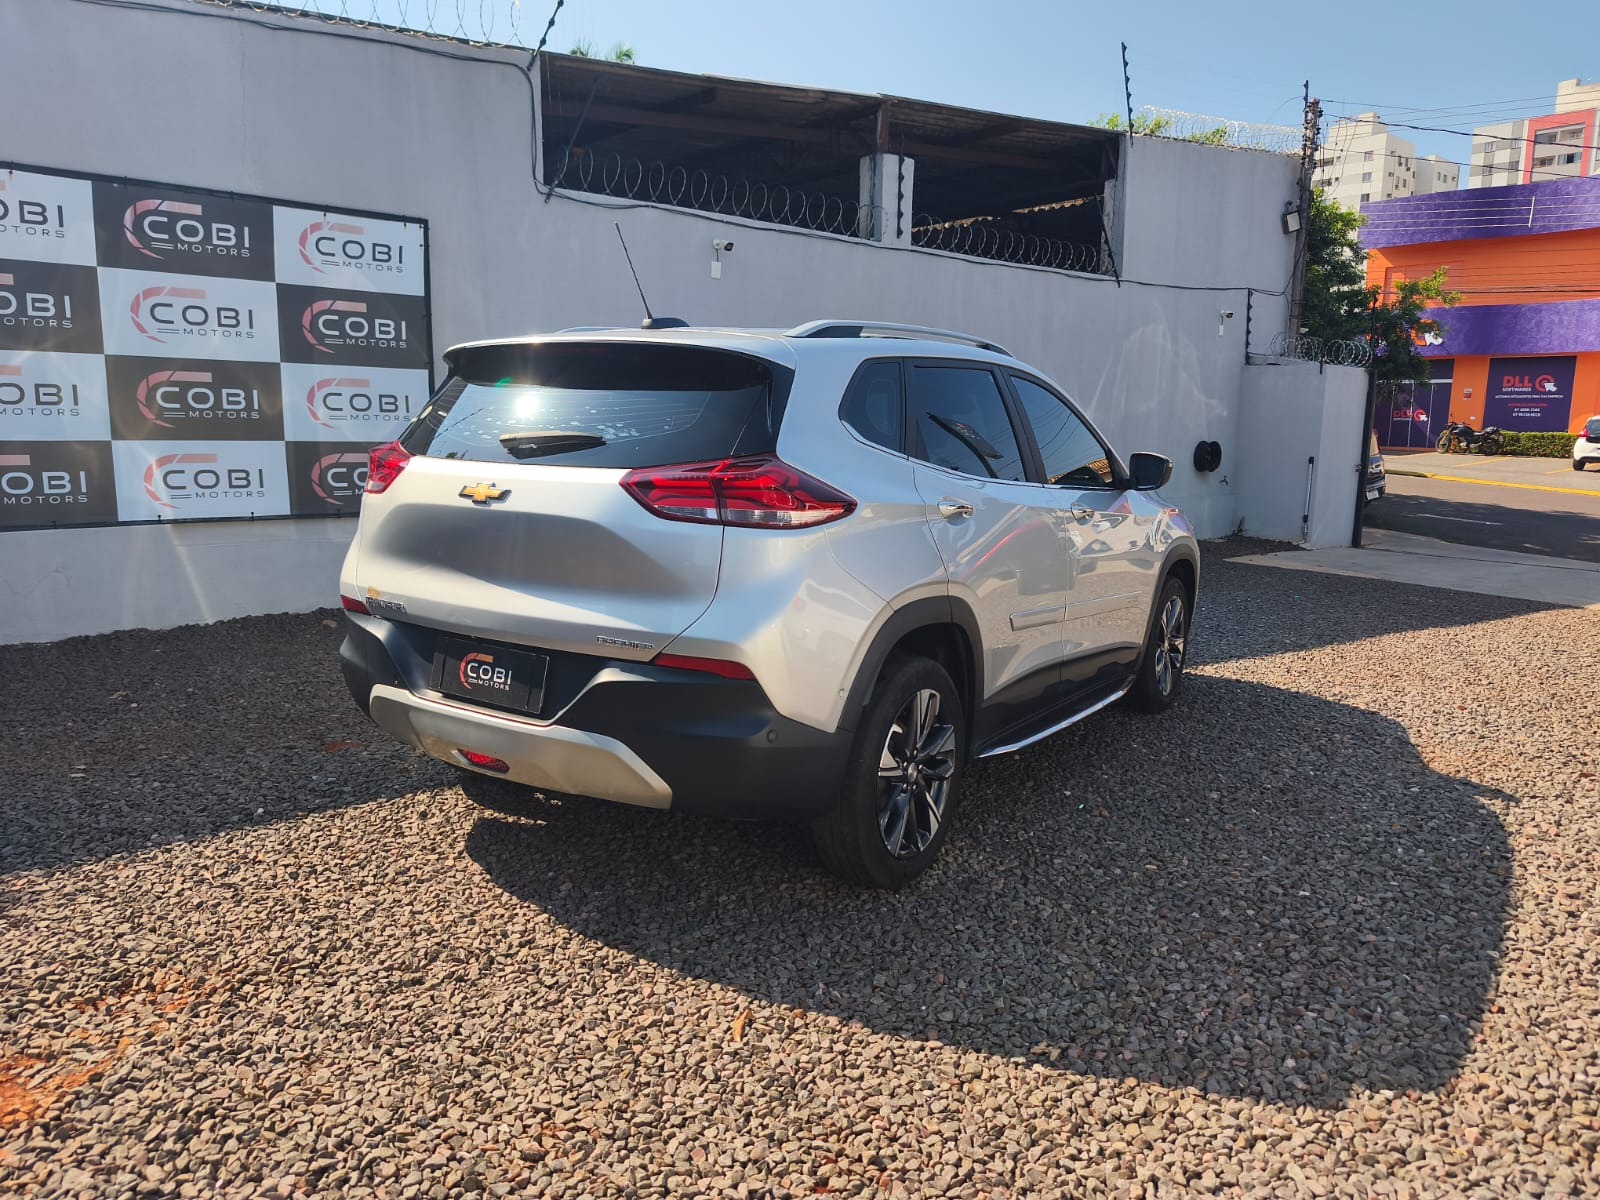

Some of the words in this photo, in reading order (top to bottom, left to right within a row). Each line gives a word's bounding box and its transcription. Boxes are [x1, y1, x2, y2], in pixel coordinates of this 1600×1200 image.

[0, 198, 64, 228] BI
[0, 223, 65, 239] OTORS
[143, 216, 250, 248] COBI
[177, 243, 250, 258] MOTORS
[315, 236, 403, 265] COBI
[342, 260, 403, 273] MOTORS
[0, 291, 72, 318] OBI
[3, 316, 73, 329] OTORS
[150, 302, 254, 330] COBI
[183, 328, 255, 339] MOTORS
[318, 314, 407, 340] COBI
[346, 338, 407, 349] MOTORS
[1502, 375, 1533, 387] DLL
[0, 382, 79, 406] OBI
[155, 386, 259, 410] COBI
[322, 392, 410, 414] COBI
[189, 410, 260, 420] MOTORS
[350, 414, 411, 422] MOTORS
[1, 470, 87, 495] OBI
[162, 468, 264, 490] COBI
[327, 467, 369, 487] CO
[3, 495, 88, 505] MOTORS
[195, 490, 265, 499] MOTORS
[467, 662, 512, 685] COBI
[478, 678, 510, 691] MOTORS
